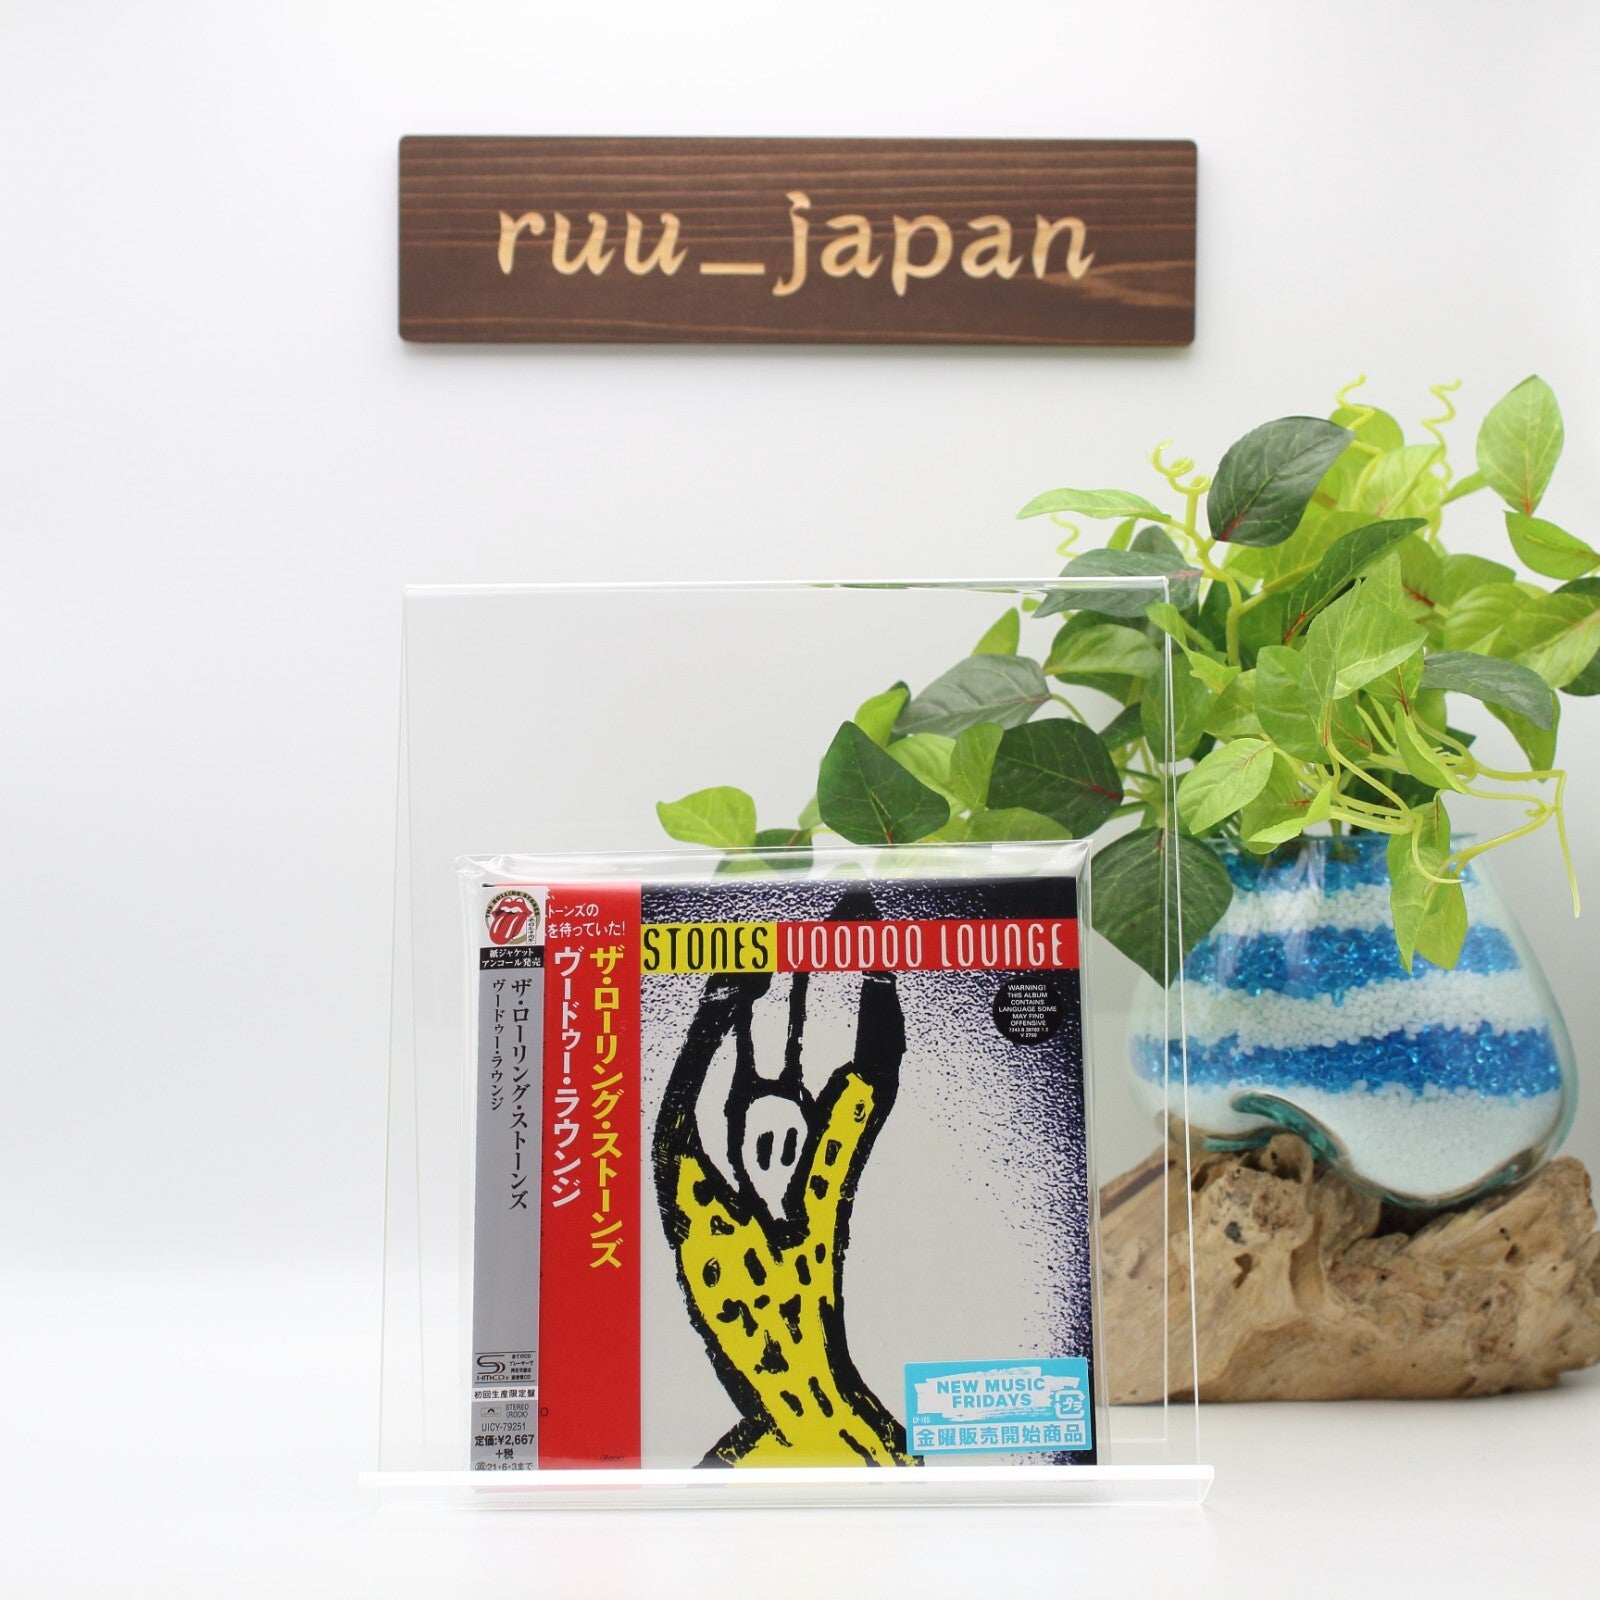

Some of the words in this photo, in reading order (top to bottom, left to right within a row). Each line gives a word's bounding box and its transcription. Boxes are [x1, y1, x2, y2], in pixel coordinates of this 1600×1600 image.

[496, 190, 1096, 297] ruu_japan
[545, 902, 600, 919] トーンズの
[545, 920, 627, 939] を待っていた!
[489, 947, 535, 958] 紙ジャケット
[642, 925, 770, 971] STONES
[786, 924, 923, 970] VOODOO
[940, 922, 1064, 968] LOUNGE
[481, 957, 542, 968] アンコール発売
[551, 945, 585, 1208] ヴードゥー・ラウンジ
[508, 977, 533, 1211] ザ・ローリング・ストーンズ
[589, 943, 626, 1269] ザ・ローリング・ストーンズ
[474, 1388, 536, 1399] 初回生産限定盤
[936, 1379, 978, 1394] NEW
[985, 1377, 1046, 1392] MUSIC
[505, 1403, 529, 1411] STEREO
[952, 1393, 1033, 1409] FRIDAYS
[481, 1422, 526, 1432] UICY-79251
[916, 1423, 1083, 1448] 金曜販売開始商品
